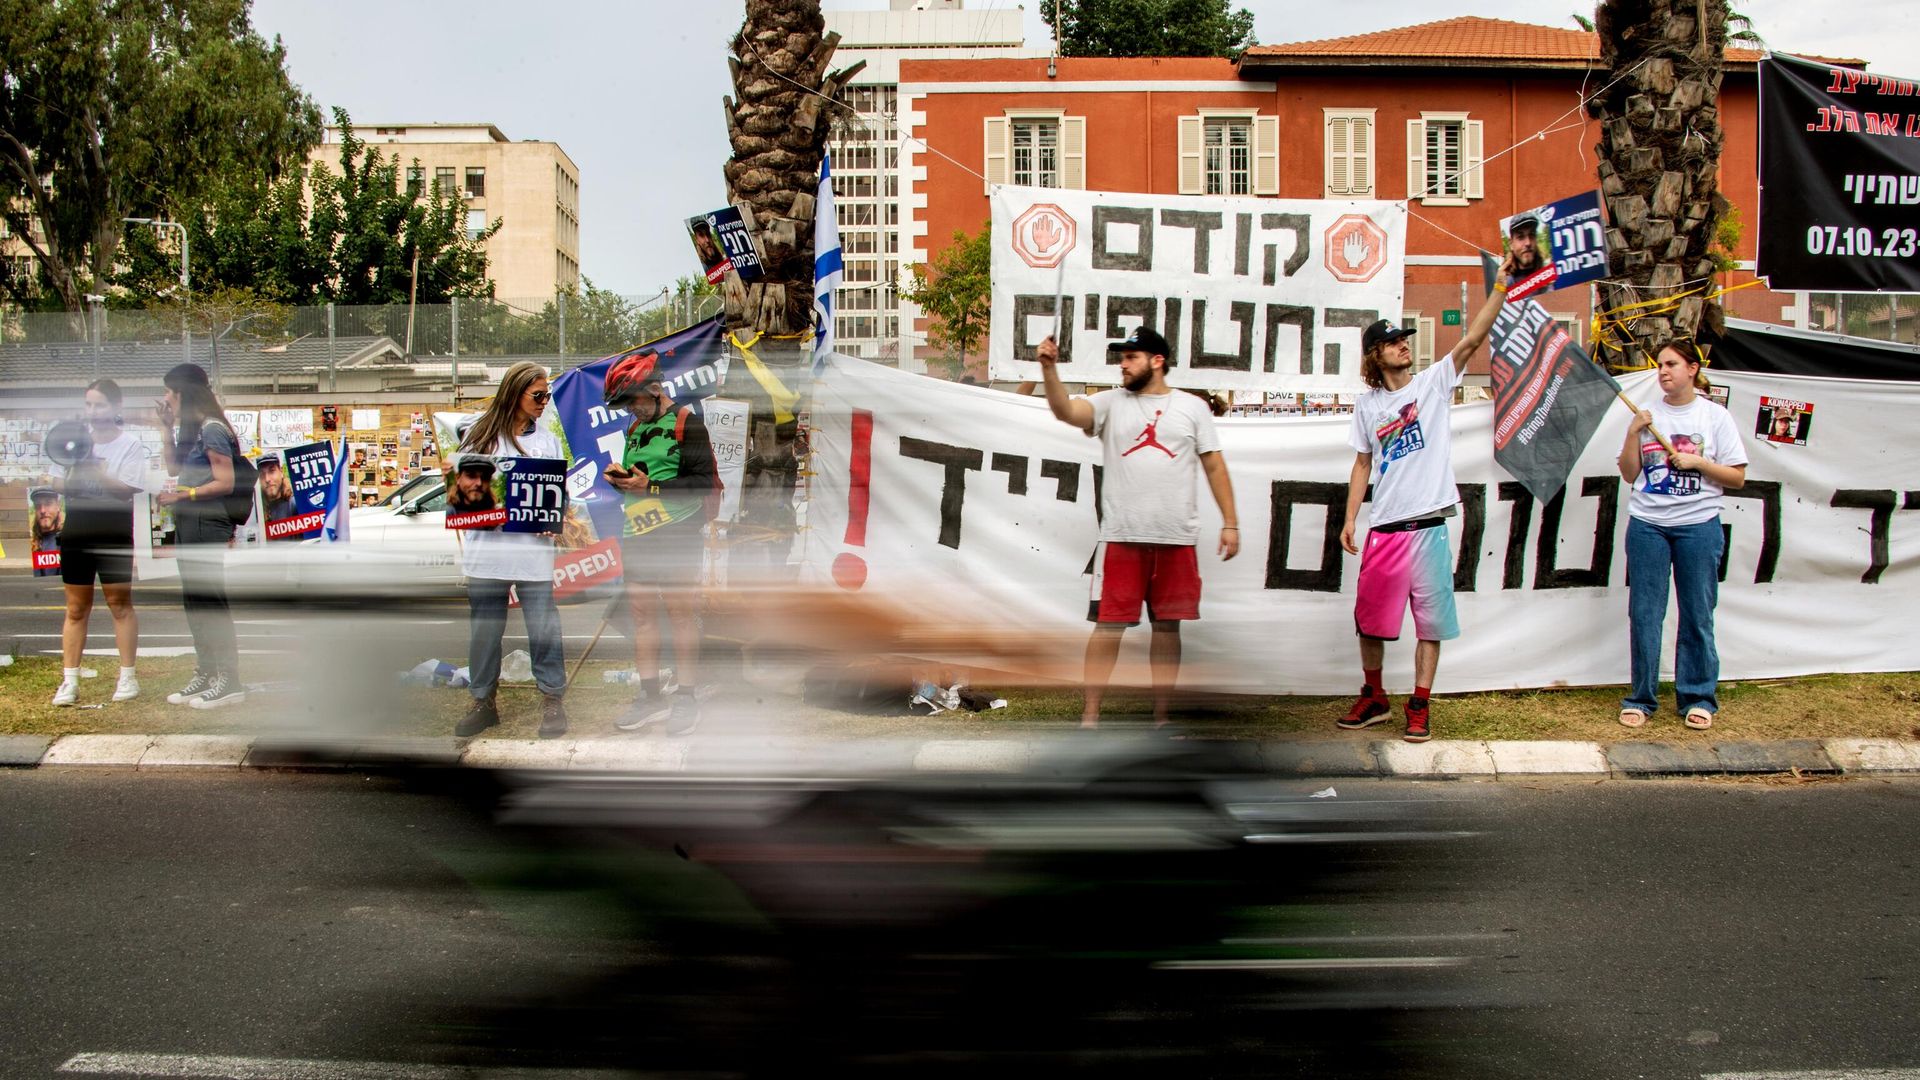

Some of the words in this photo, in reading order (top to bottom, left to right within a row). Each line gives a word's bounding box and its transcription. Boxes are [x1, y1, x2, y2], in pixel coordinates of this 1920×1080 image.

[1806, 105, 1860, 133] הלב.
[1864, 112, 1899, 136] את
[721, 229, 753, 254] רוני
[1091, 205, 1311, 286] קודם
[1553, 221, 1603, 256] רוני
[731, 253, 758, 269] הביתה
[1556, 250, 1605, 275] הביתה
[1508, 267, 1556, 298] KIDNAPPED!
[1012, 292, 1379, 375] החטופים
[1501, 299, 1552, 366] הביתה
[1268, 391, 1293, 400] SAVE
[1767, 396, 1806, 410] KIDNAPPED
[291, 457, 333, 479] רוני
[511, 472, 526, 481] את
[528, 472, 564, 483] מחזירים
[295, 474, 333, 491] הביתה
[1669, 475, 1700, 490] רוני
[511, 482, 563, 508] רוני
[446, 511, 506, 528] KIDNAPPED!
[509, 508, 561, 522] הביתה
[1264, 477, 1783, 593] הטום
